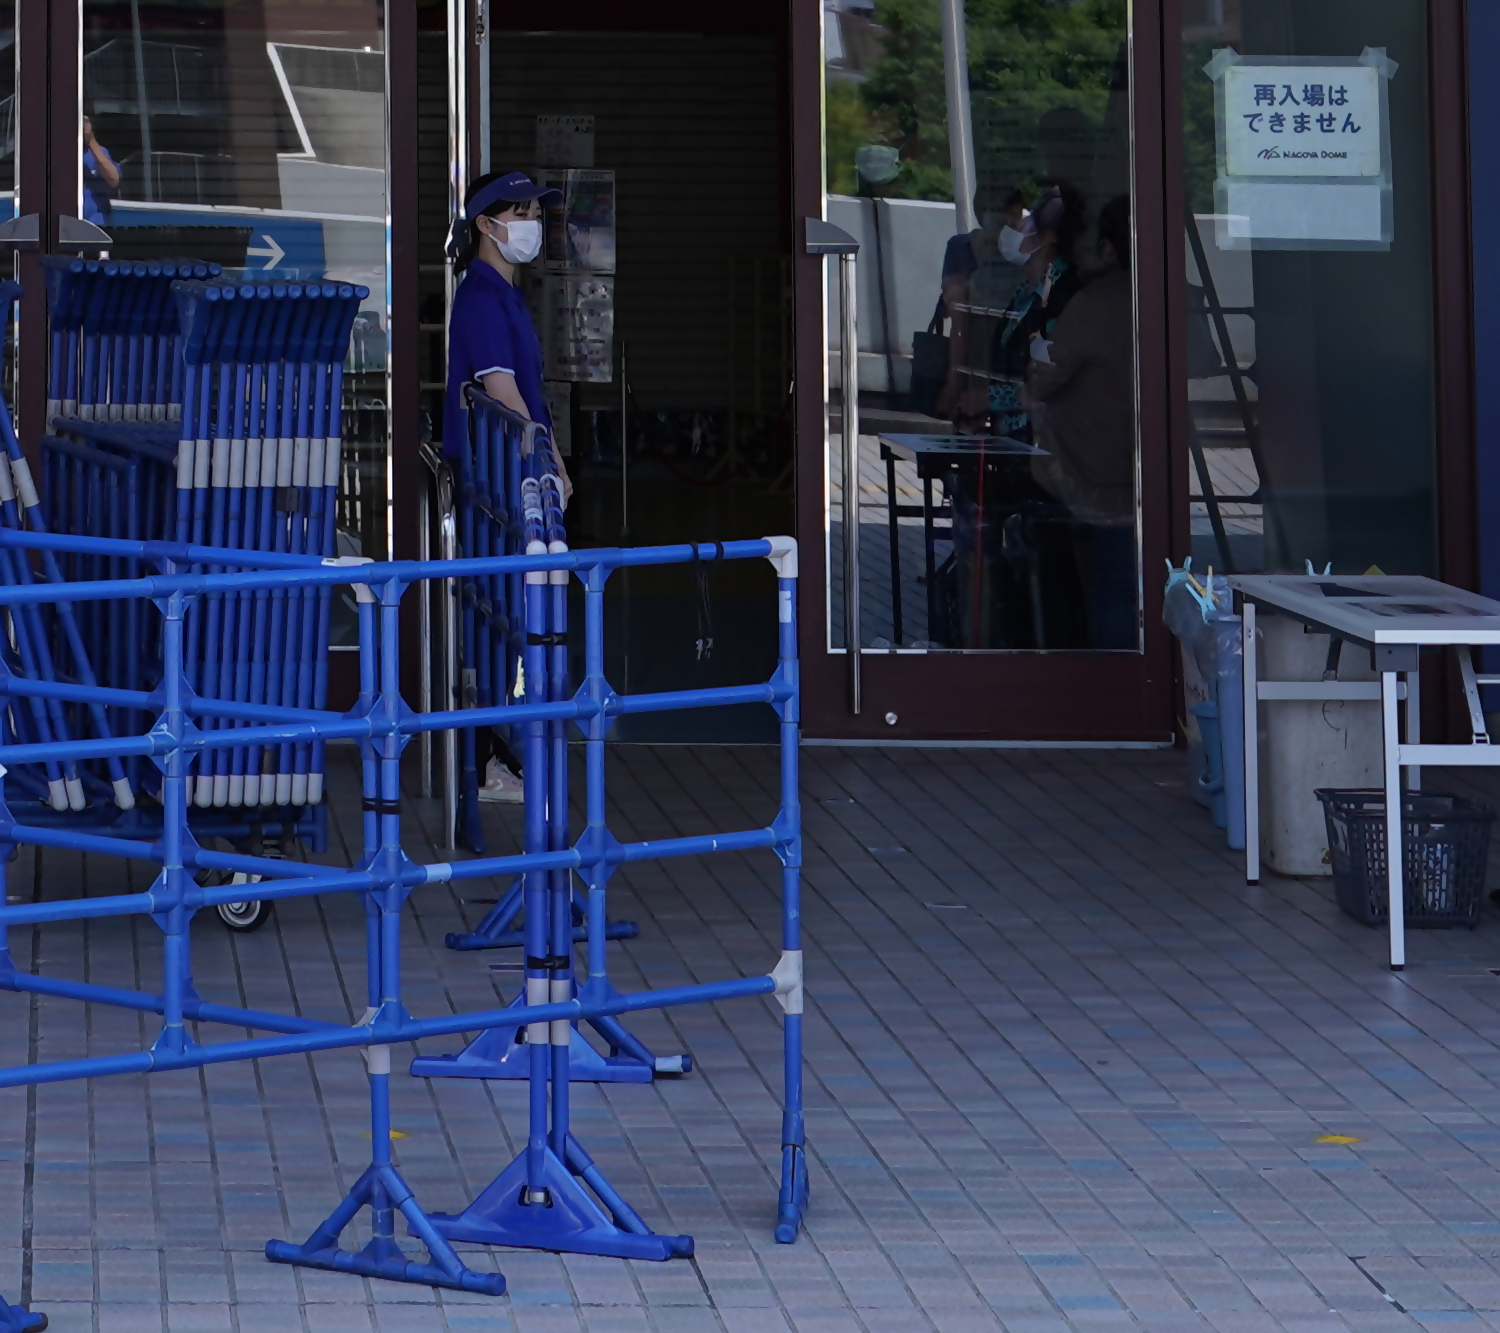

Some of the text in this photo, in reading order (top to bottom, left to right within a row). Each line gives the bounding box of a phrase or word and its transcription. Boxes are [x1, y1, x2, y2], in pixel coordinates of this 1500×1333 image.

[1253, 84, 1349, 107] 再入場は
[1243, 112, 1361, 133] できません
[1321, 151, 1348, 159] DOME
